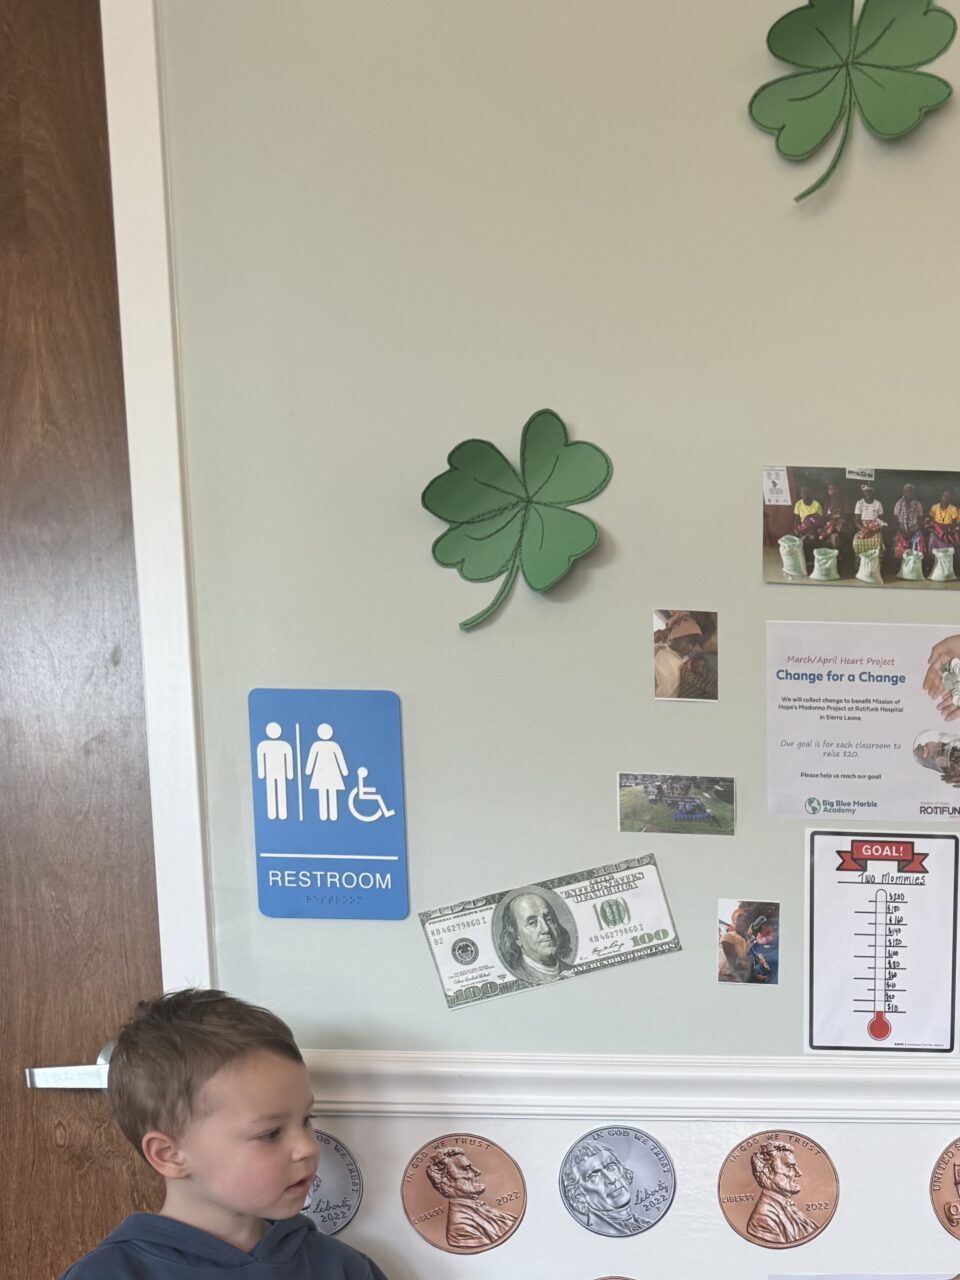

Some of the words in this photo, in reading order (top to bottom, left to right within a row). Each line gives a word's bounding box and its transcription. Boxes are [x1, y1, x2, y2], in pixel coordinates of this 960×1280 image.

[787, 656, 837, 666] March/April
[866, 658, 895, 667] Project
[776, 670, 823, 683] Change
[827, 671, 844, 681] for
[859, 672, 905, 685] Change
[827, 705, 846, 713] Project
[781, 740, 795, 748] Our
[798, 740, 812, 749] goal
[823, 741, 833, 750] for
[856, 742, 891, 750] classroom
[823, 807, 856, 815] Academy
[862, 845, 904, 856] GOAL!
[269, 870, 391, 889] RESTROOM
[882, 873, 925, 885] Mommies
[631, 929, 669, 947] 100
[453, 982, 500, 1004] 100
[730, 1152, 740, 1163] IN
[741, 1138, 759, 1152] GOD
[789, 1135, 822, 1156] TRUST
[932, 1150, 955, 1191] UNITED
[495, 1191, 520, 1206] 2022
[634, 1180, 669, 1205] Liberty
[722, 1194, 755, 1203] LIBERTY
[643, 1195, 667, 1211] 2022
[806, 1202, 829, 1211] 2022
[413, 1207, 445, 1225] LIBERTY
